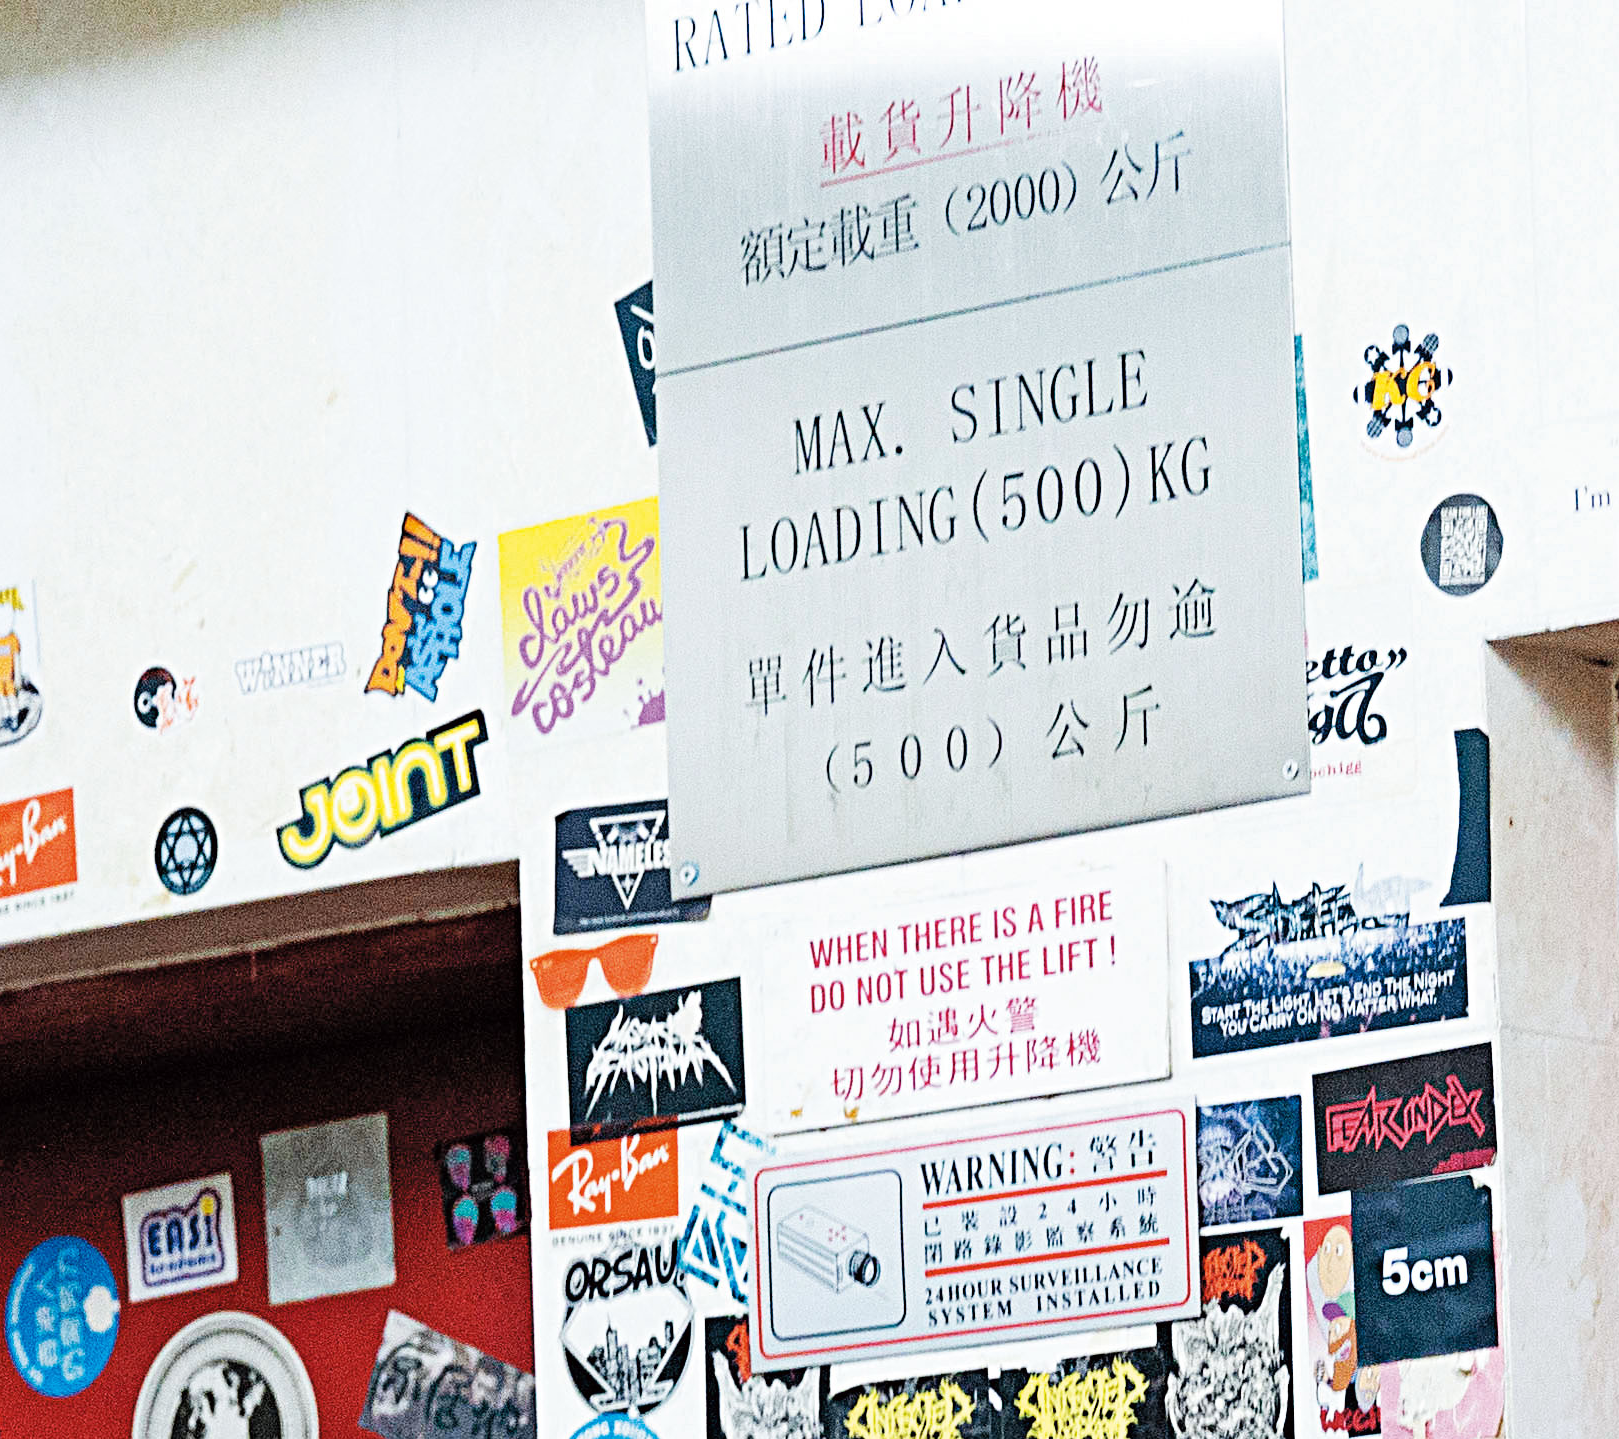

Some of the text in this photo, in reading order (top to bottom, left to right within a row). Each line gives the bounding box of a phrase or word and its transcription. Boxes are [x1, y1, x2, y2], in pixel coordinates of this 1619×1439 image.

[818, 56, 1104, 175] 載貨升降機
[740, 131, 1193, 288] 額定載重 (2000) 公斤
[793, 349, 1150, 476] MAX. SINGLE
[746, 578, 1219, 719] 單件進入貨品勿逾
[825, 685, 1162, 792] (500) 公斤
[277, 710, 486, 870] JOINT
[810, 889, 1115, 970] WHEN THERE IS A FIRE
[810, 977, 849, 1016] DO
[854, 970, 912, 1012] NOT
[919, 959, 973, 1004] USE
[979, 948, 1033, 994] THE
[1041, 939, 1097, 984] LIFT
[1413, 969, 1456, 1001] NIGHT
[885, 996, 1041, 1053] 如遇火警
[831, 1030, 1103, 1103] 切勿使用升降機
[550, 1128, 671, 1215] Ray-Ban
[920, 1130, 1159, 1198] WARNING: 警告
[925, 1256, 1163, 1306] 24HOUR SURVEILLANCE
[927, 1279, 1161, 1328] SYSTEM INSTALLED
[1380, 1246, 1468, 1297] 5cm
